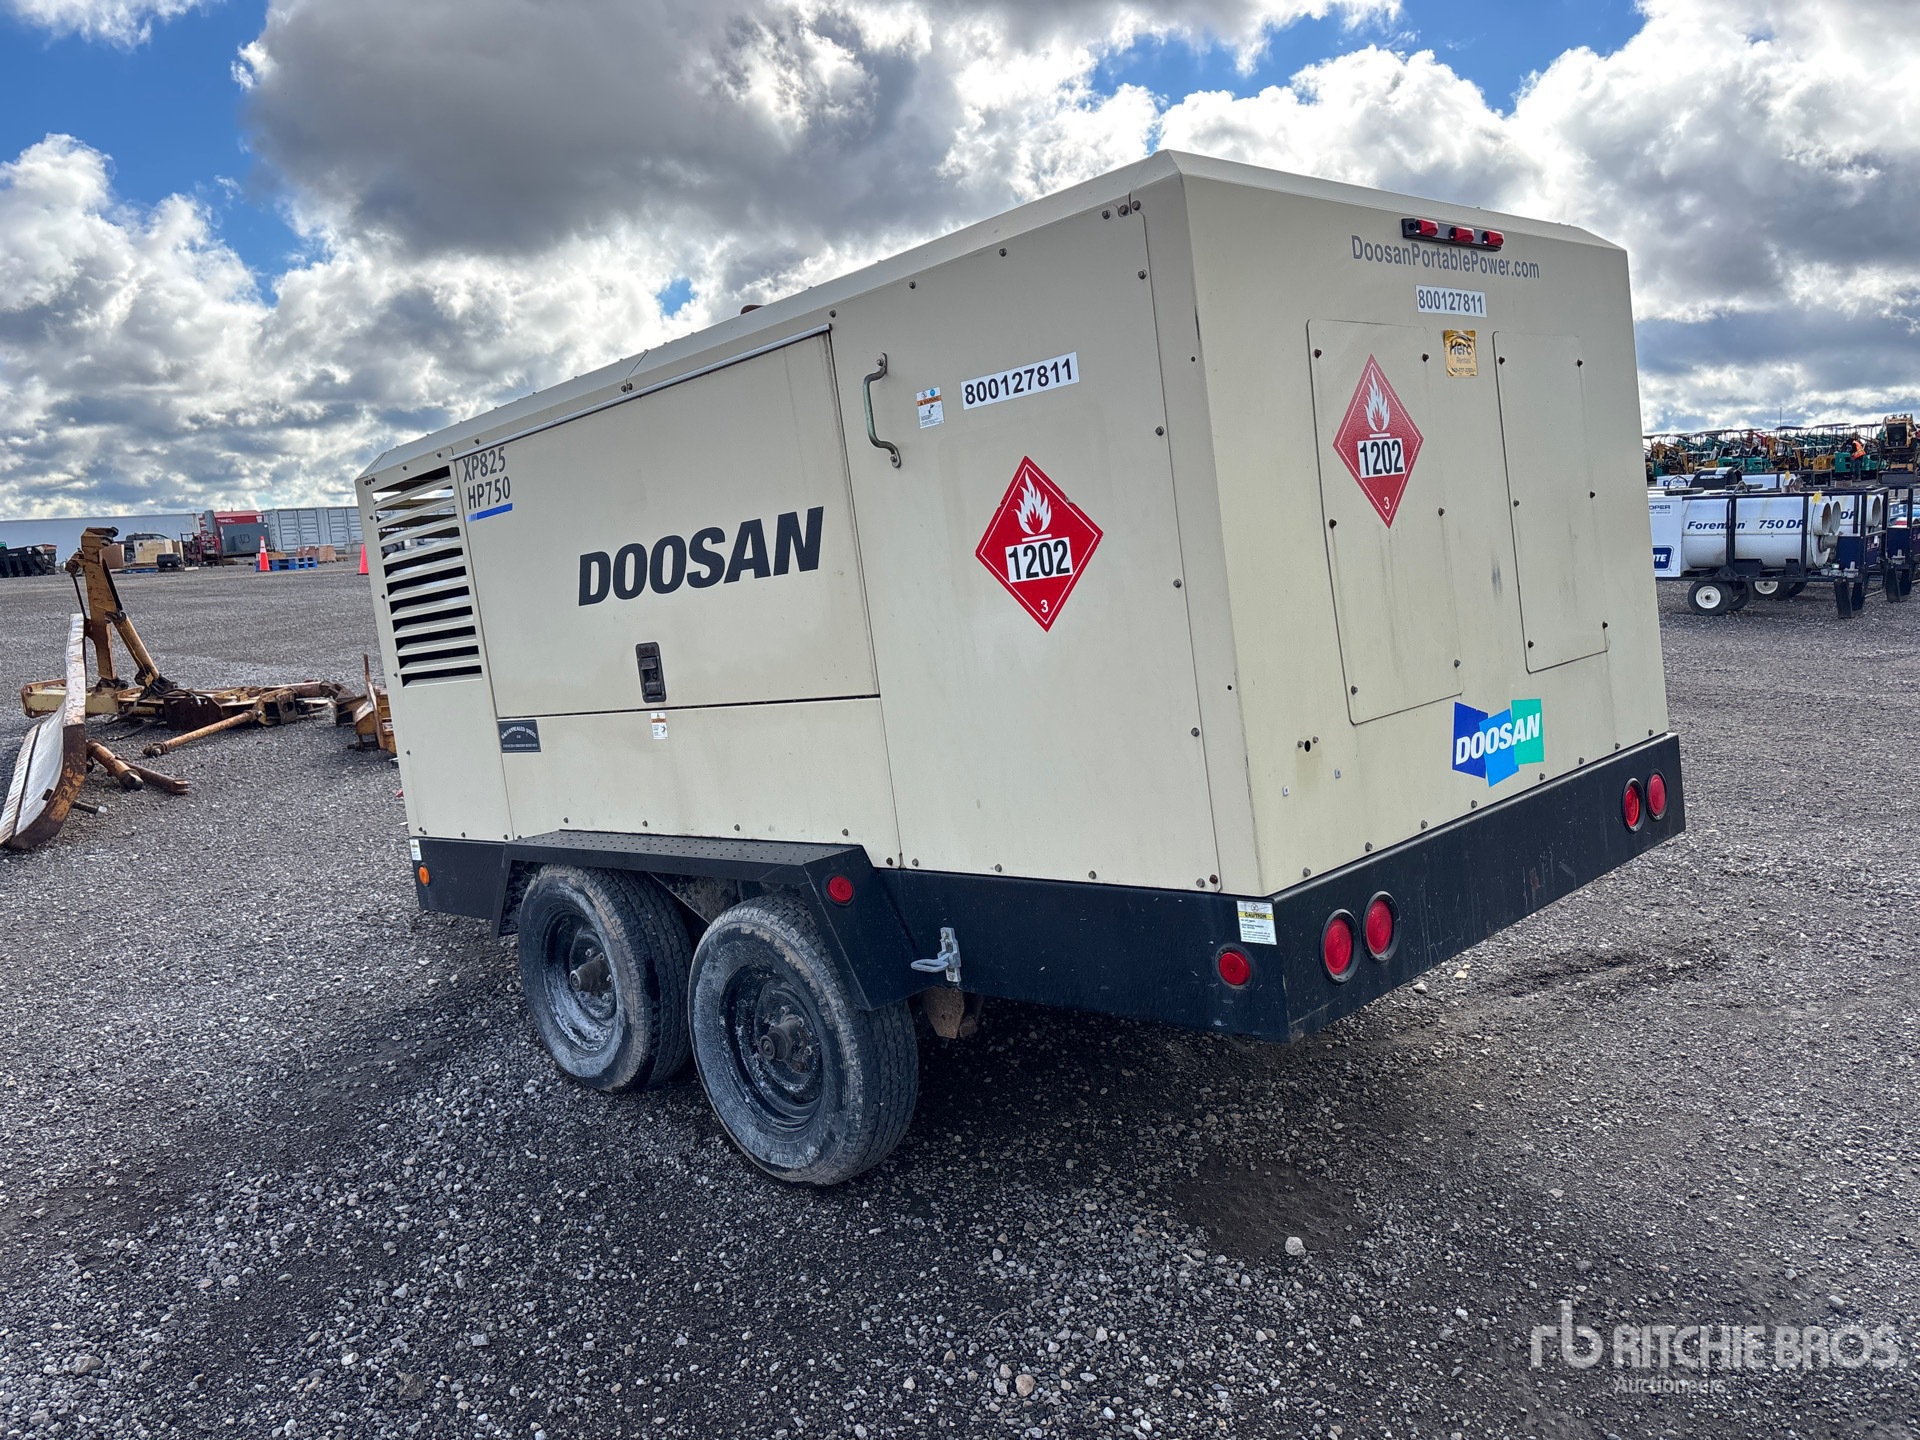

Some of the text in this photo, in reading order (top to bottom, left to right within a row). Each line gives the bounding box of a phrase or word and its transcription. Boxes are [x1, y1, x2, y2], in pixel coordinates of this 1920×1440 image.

[1352, 235, 1540, 278] DoosanPortablePower.com
[1418, 289, 1483, 313] 800127811
[964, 358, 1072, 405] 800127811
[463, 446, 505, 482] XP825
[1360, 440, 1403, 475] 1202
[468, 476, 510, 509] HP750
[1384, 497, 1390, 509] 3
[1687, 521, 1746, 530] Foremn
[1759, 520, 1784, 529] 750
[578, 506, 824, 606] DOOSAN
[1008, 540, 1070, 580] 1202
[1041, 600, 1048, 613] 3
[1455, 713, 1540, 765] DOOSAN
